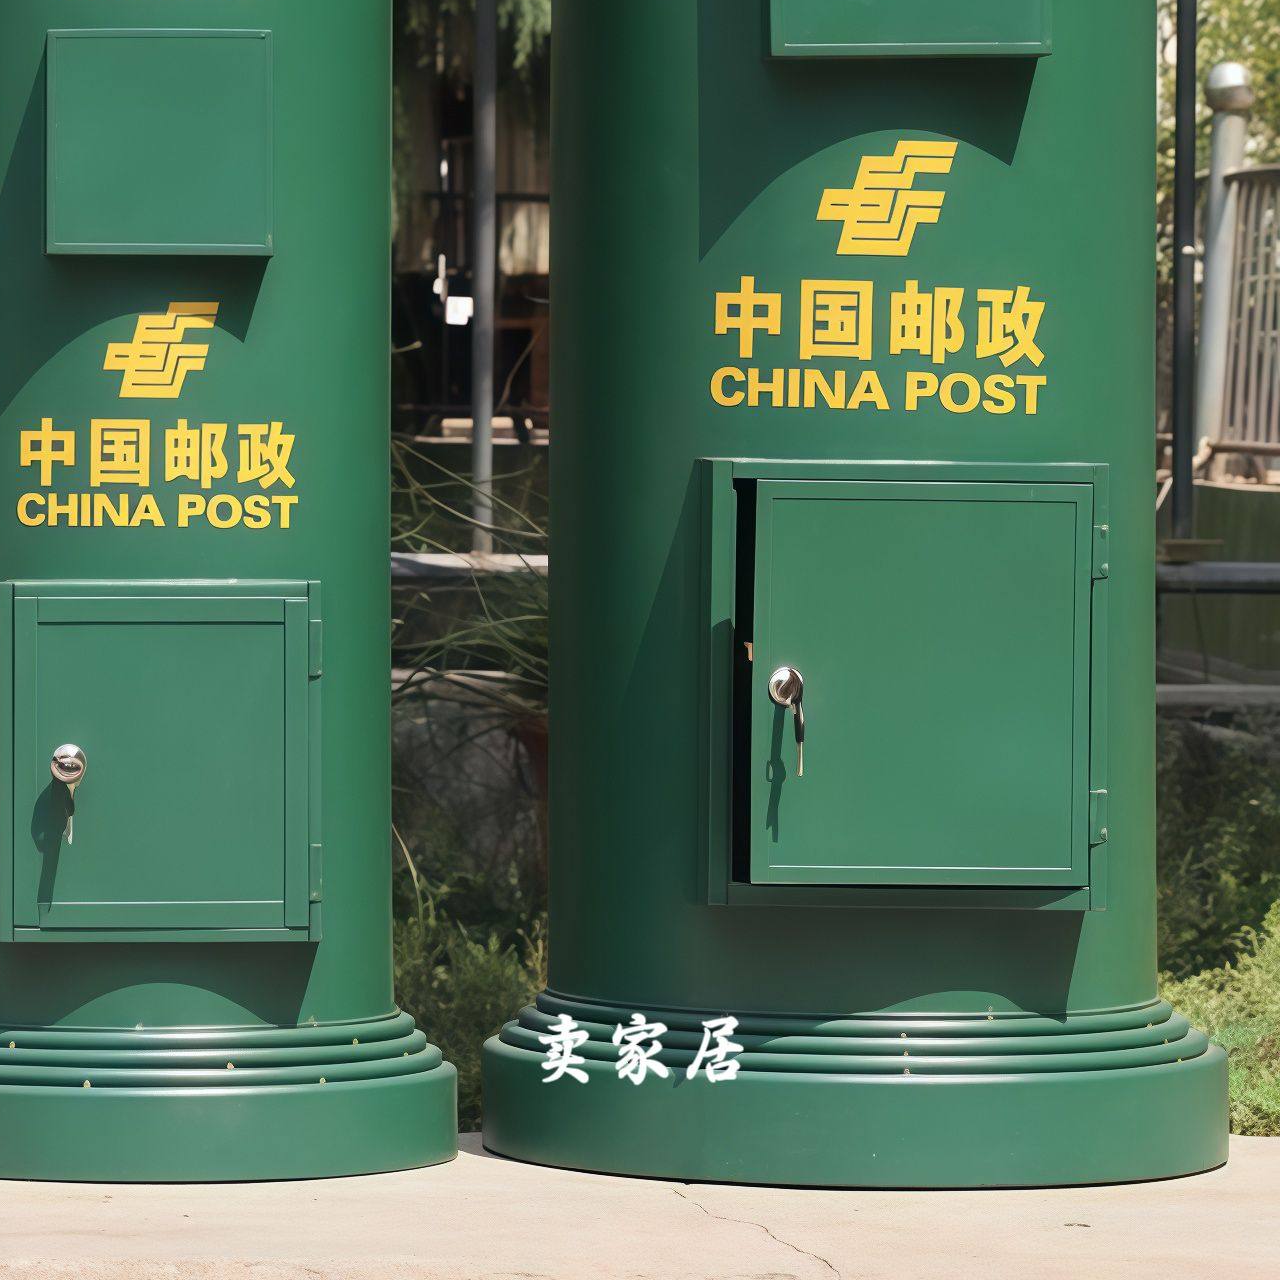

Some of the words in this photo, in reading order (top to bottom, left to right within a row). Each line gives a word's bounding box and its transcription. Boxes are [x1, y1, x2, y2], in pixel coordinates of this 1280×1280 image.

[714, 275, 1046, 369] 中国邮政
[710, 366, 891, 411] CHINA
[905, 371, 1048, 415] POST
[19, 417, 296, 490] 中国邮政
[16, 492, 166, 527] CHINA
[177, 493, 299, 529] POST
